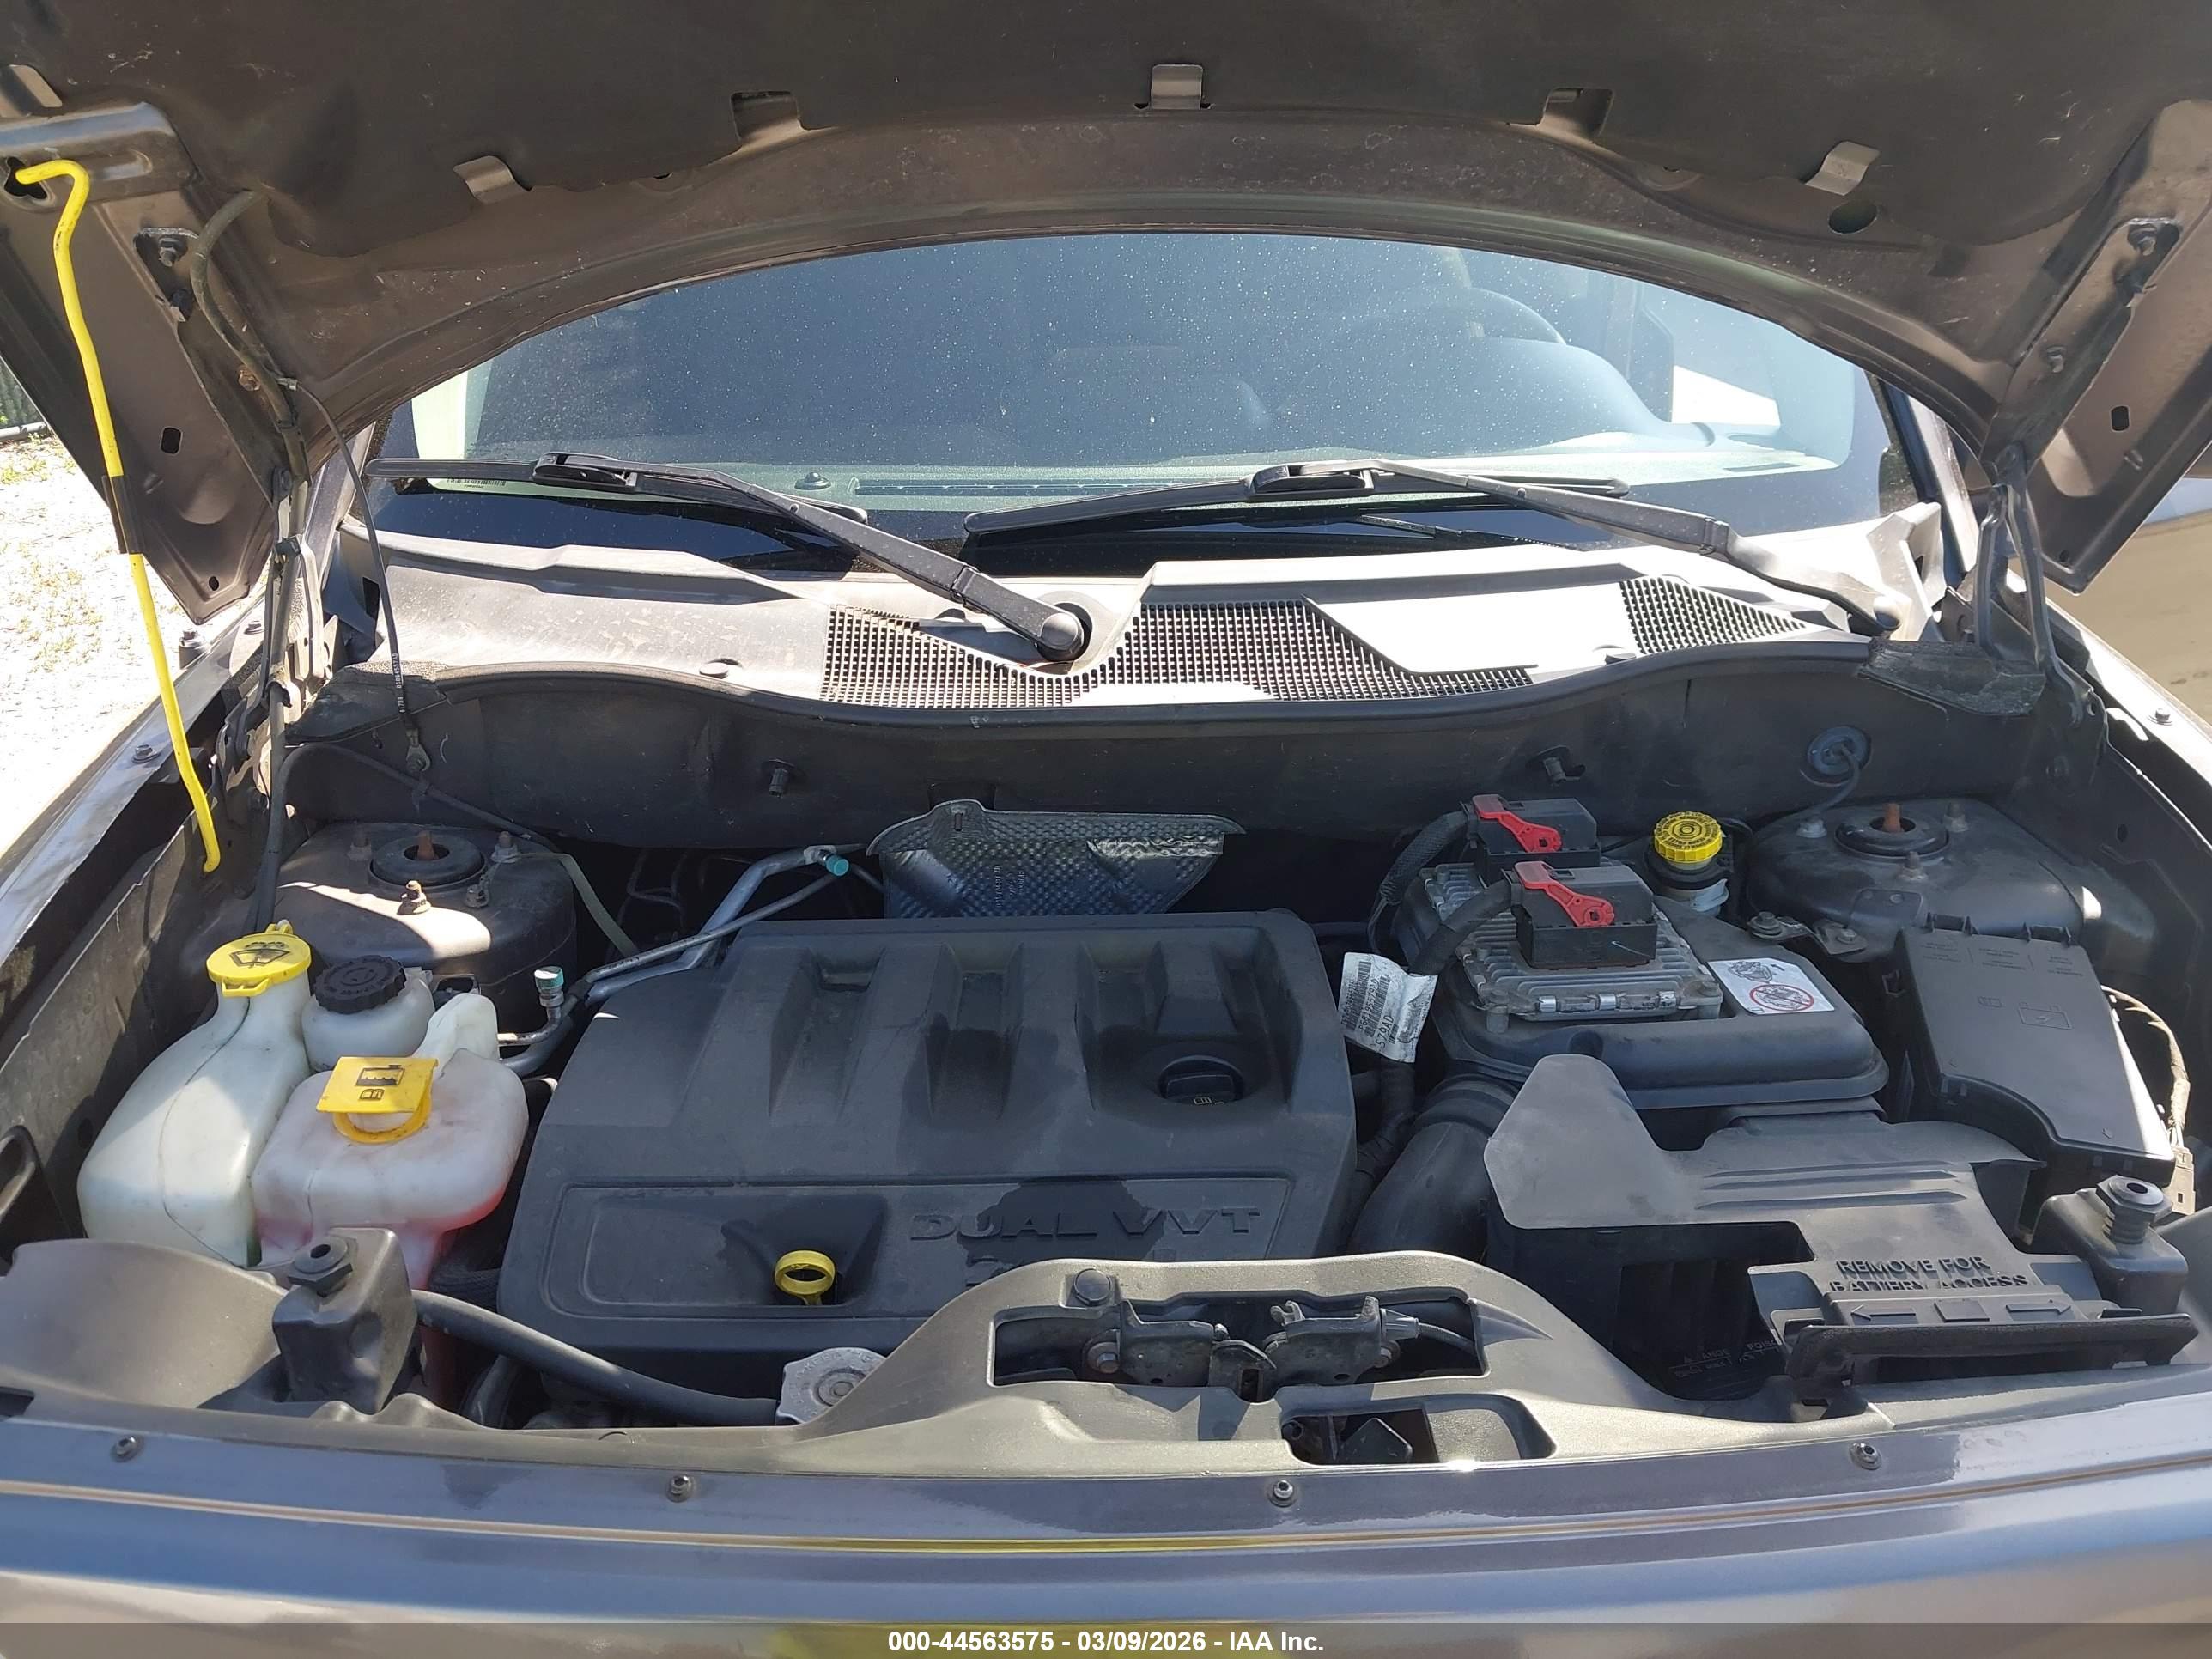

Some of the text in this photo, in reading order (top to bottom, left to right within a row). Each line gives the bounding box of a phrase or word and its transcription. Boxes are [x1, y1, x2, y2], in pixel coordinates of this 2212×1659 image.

[1376, 1015, 1394, 1048] 579AD
[910, 1207, 1261, 1241] DUAL VVT
[1836, 1256, 1992, 1277] REMOVE FOR
[1939, 1275, 2029, 1289] ACCESS
